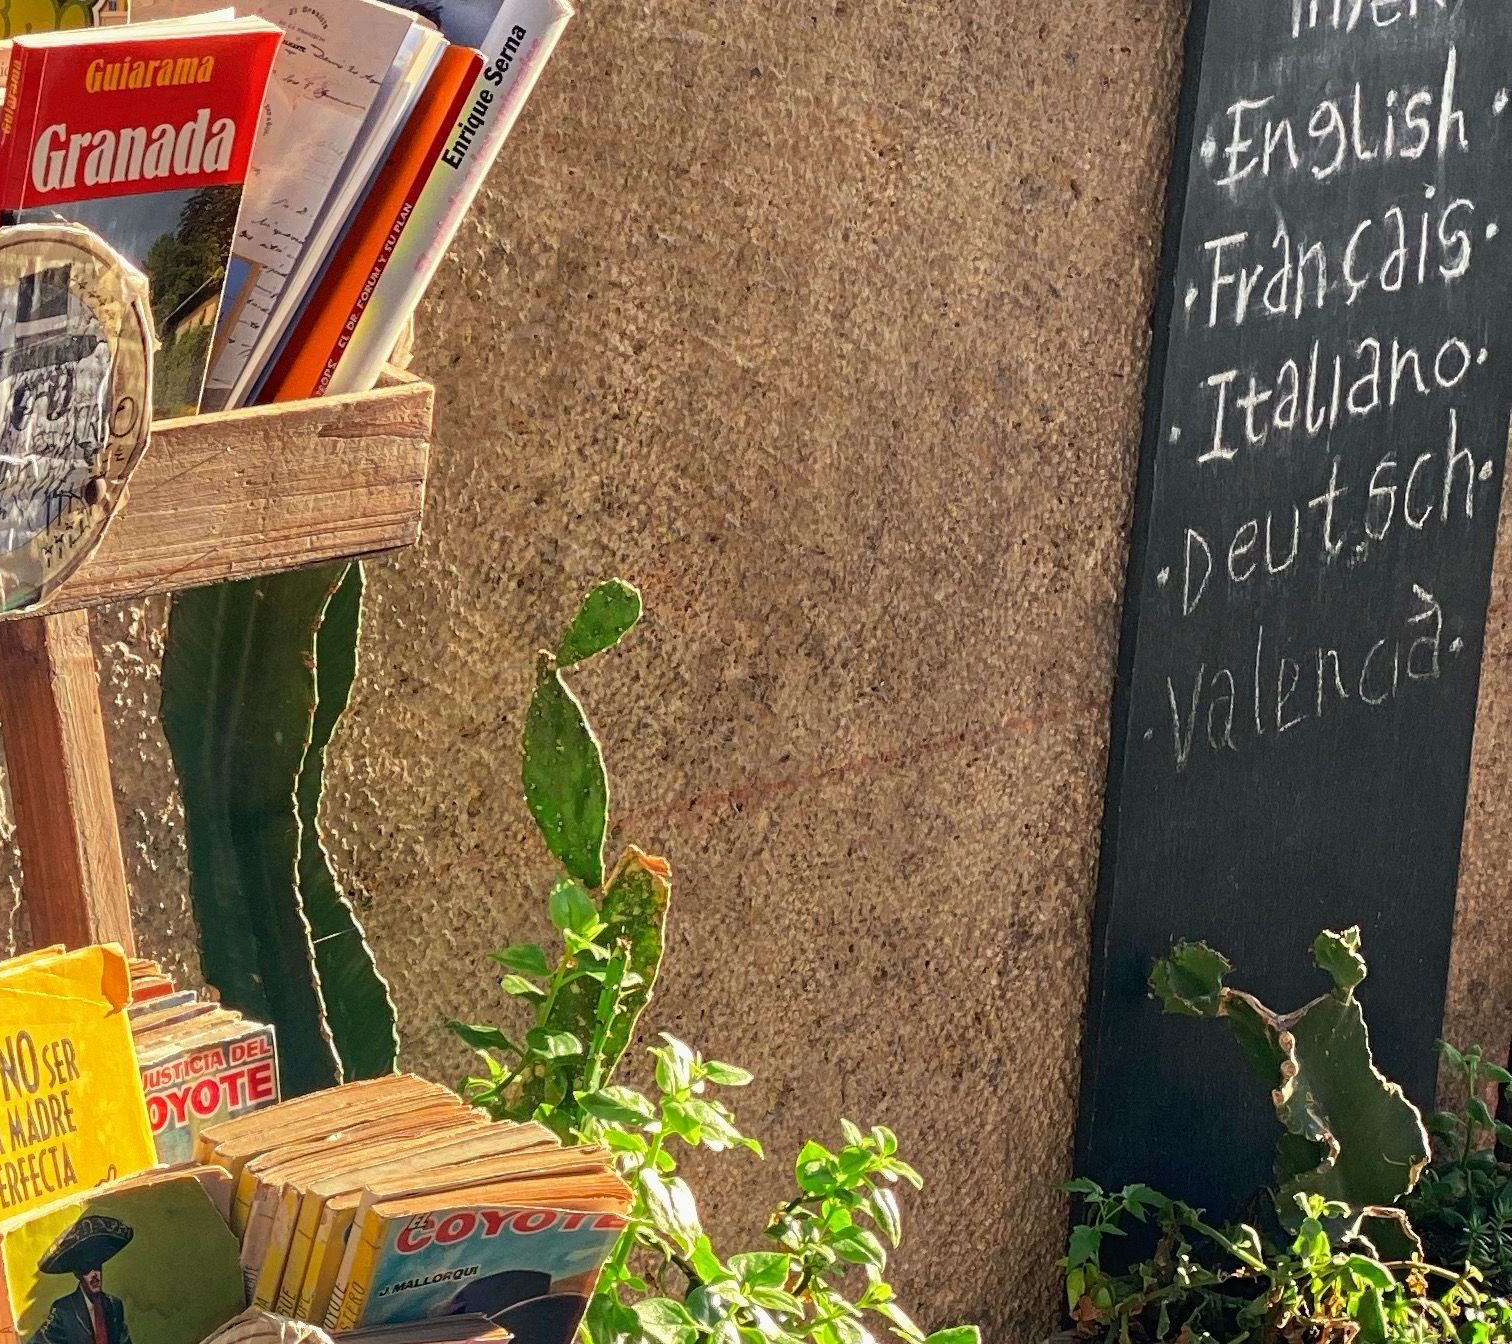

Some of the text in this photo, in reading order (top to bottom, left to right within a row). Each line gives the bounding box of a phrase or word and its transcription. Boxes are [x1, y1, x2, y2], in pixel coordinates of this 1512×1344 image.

[85, 56, 216, 94] Guiarama
[440, 23, 528, 171] Enrique Serna
[1218, 43, 1471, 186] English
[31, 107, 237, 194] Granada
[355, 267, 384, 312] FORUM
[384, 232, 398, 252] SU
[393, 201, 413, 234] PLAN
[1202, 184, 1475, 327] Français
[1196, 336, 1472, 464] Italiano
[41, 1037, 80, 1089] SER
[142, 1034, 273, 1093] JUSTICIA DEL
[7, 1089, 78, 1148] MADRE
[395, 1208, 628, 1256] EL COYOTE
